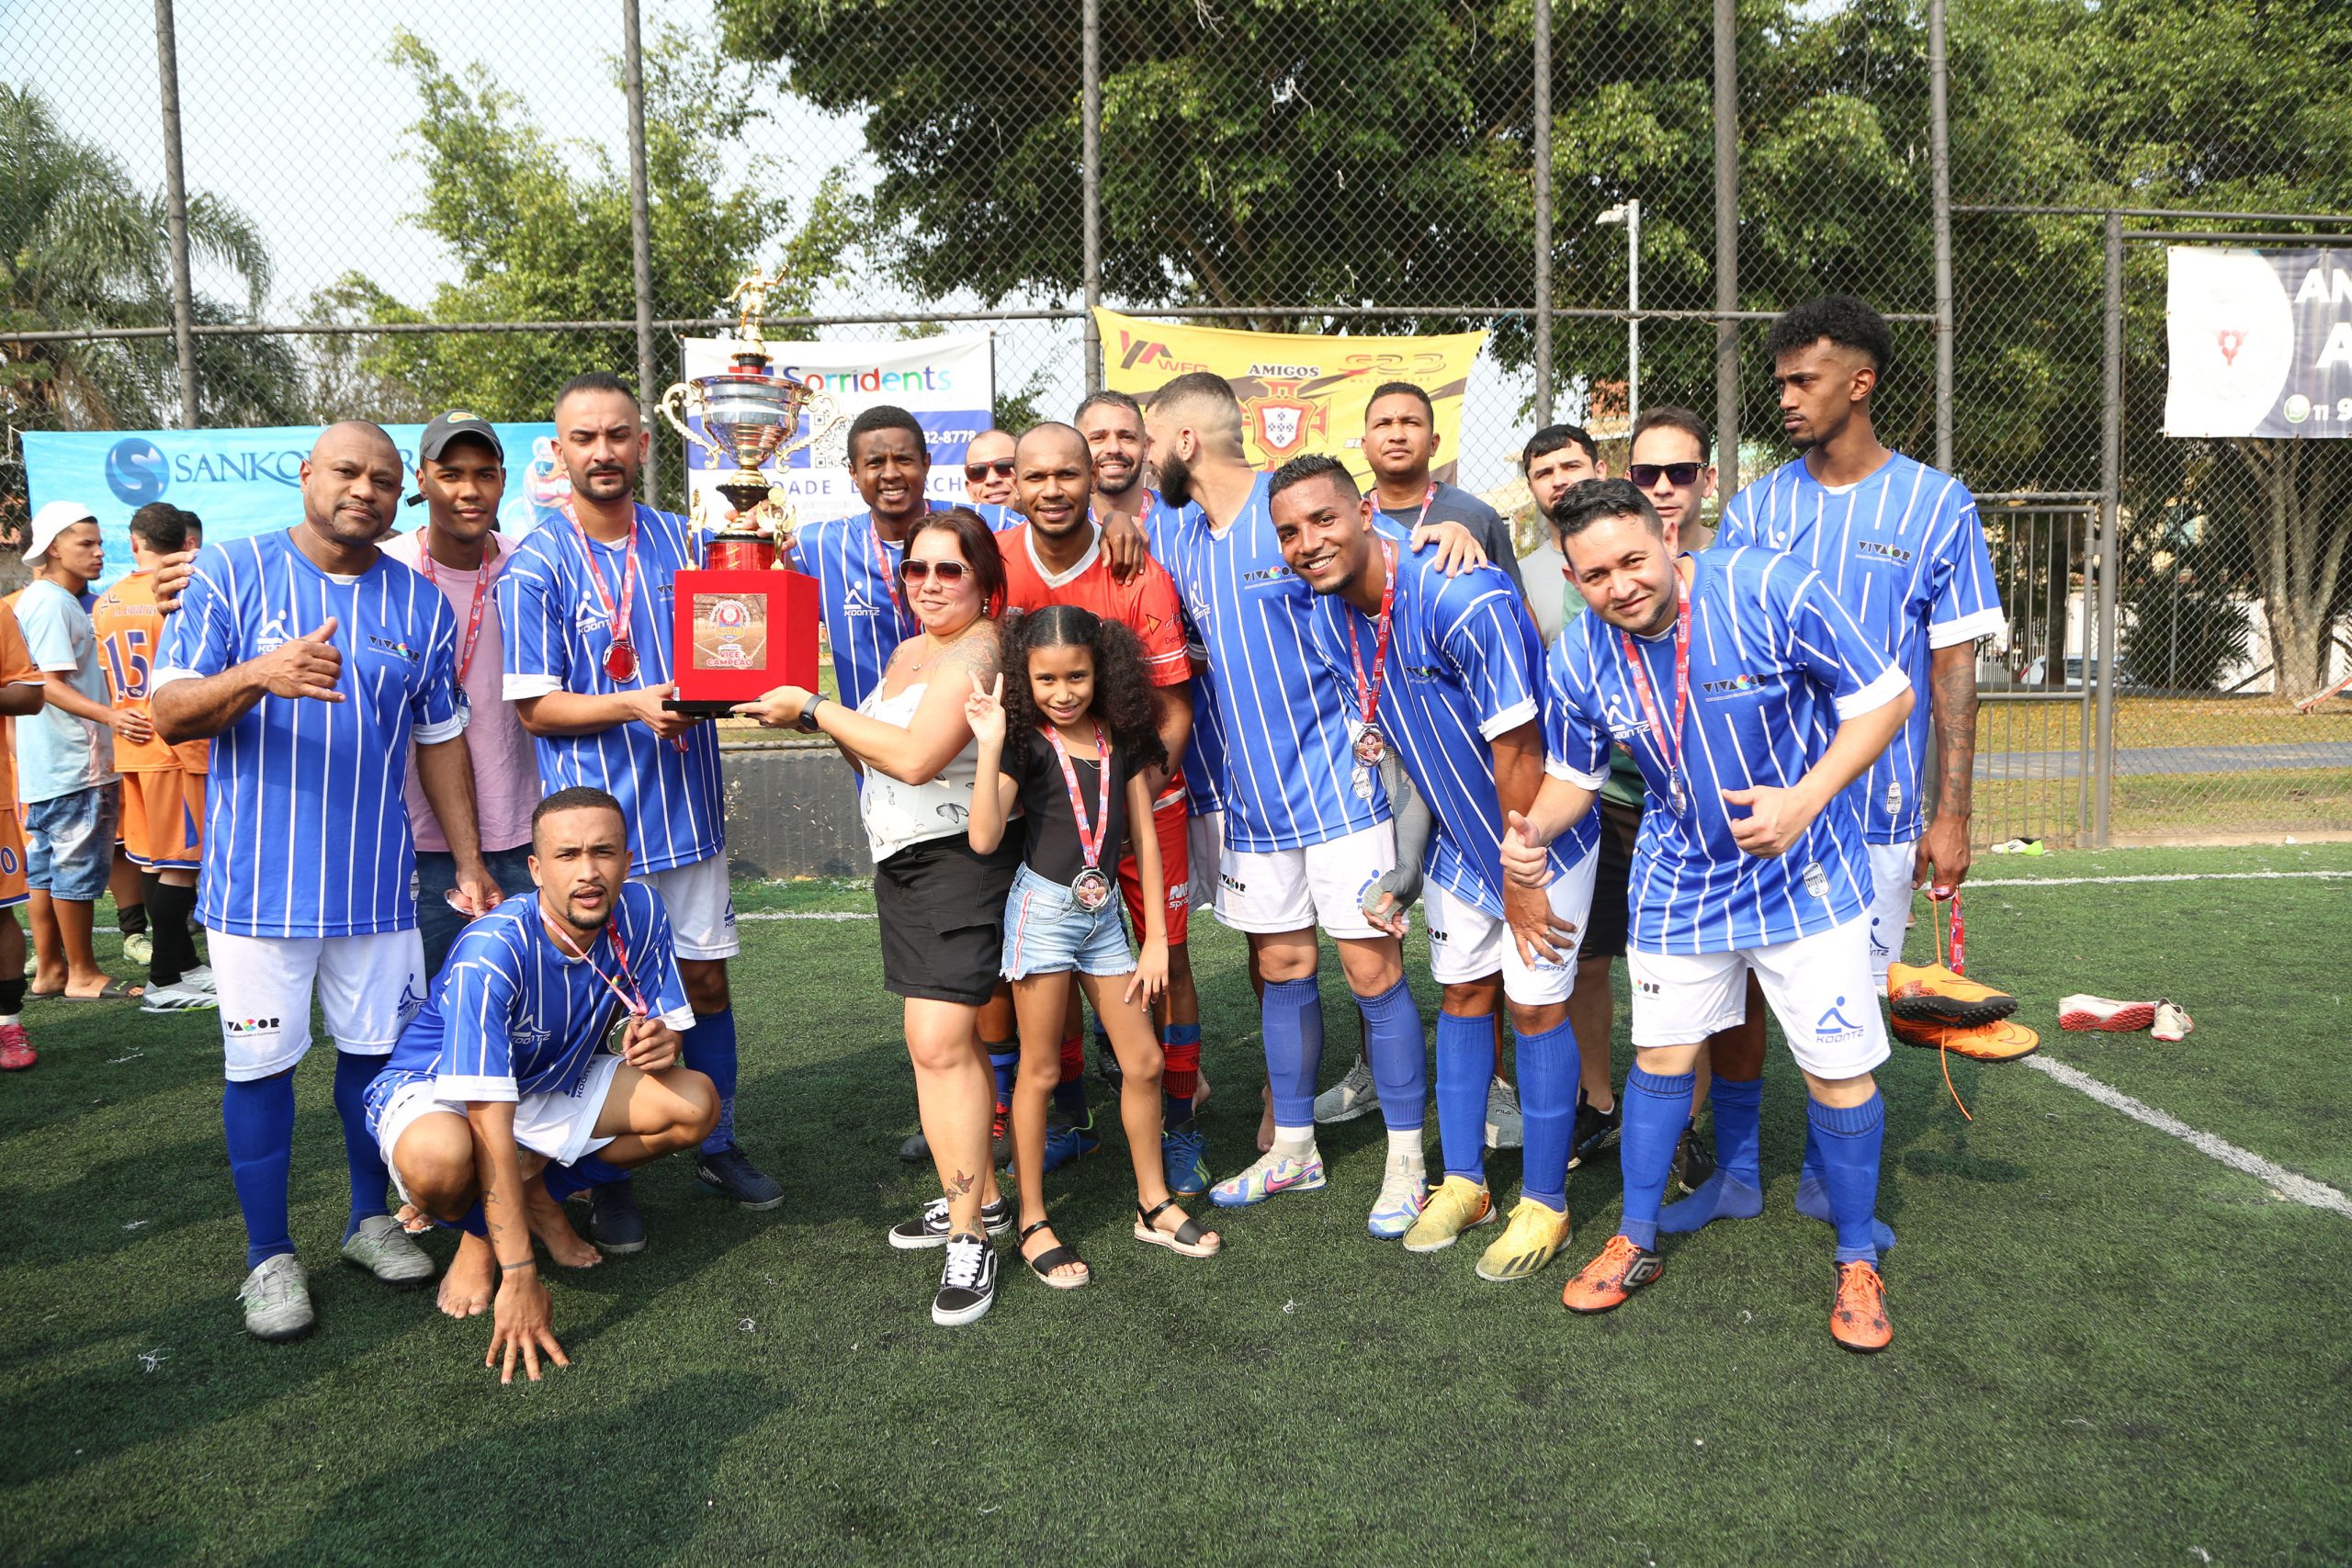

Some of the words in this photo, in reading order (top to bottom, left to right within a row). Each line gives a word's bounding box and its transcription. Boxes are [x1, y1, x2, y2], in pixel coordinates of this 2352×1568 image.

[1249, 364, 1320, 378] AMIGOS
[783, 366, 951, 393] Sorridents
[843, 609, 881, 617] KOONTZ
[103, 628, 150, 703] 15
[1815, 1029, 1865, 1044] KOONTZ
